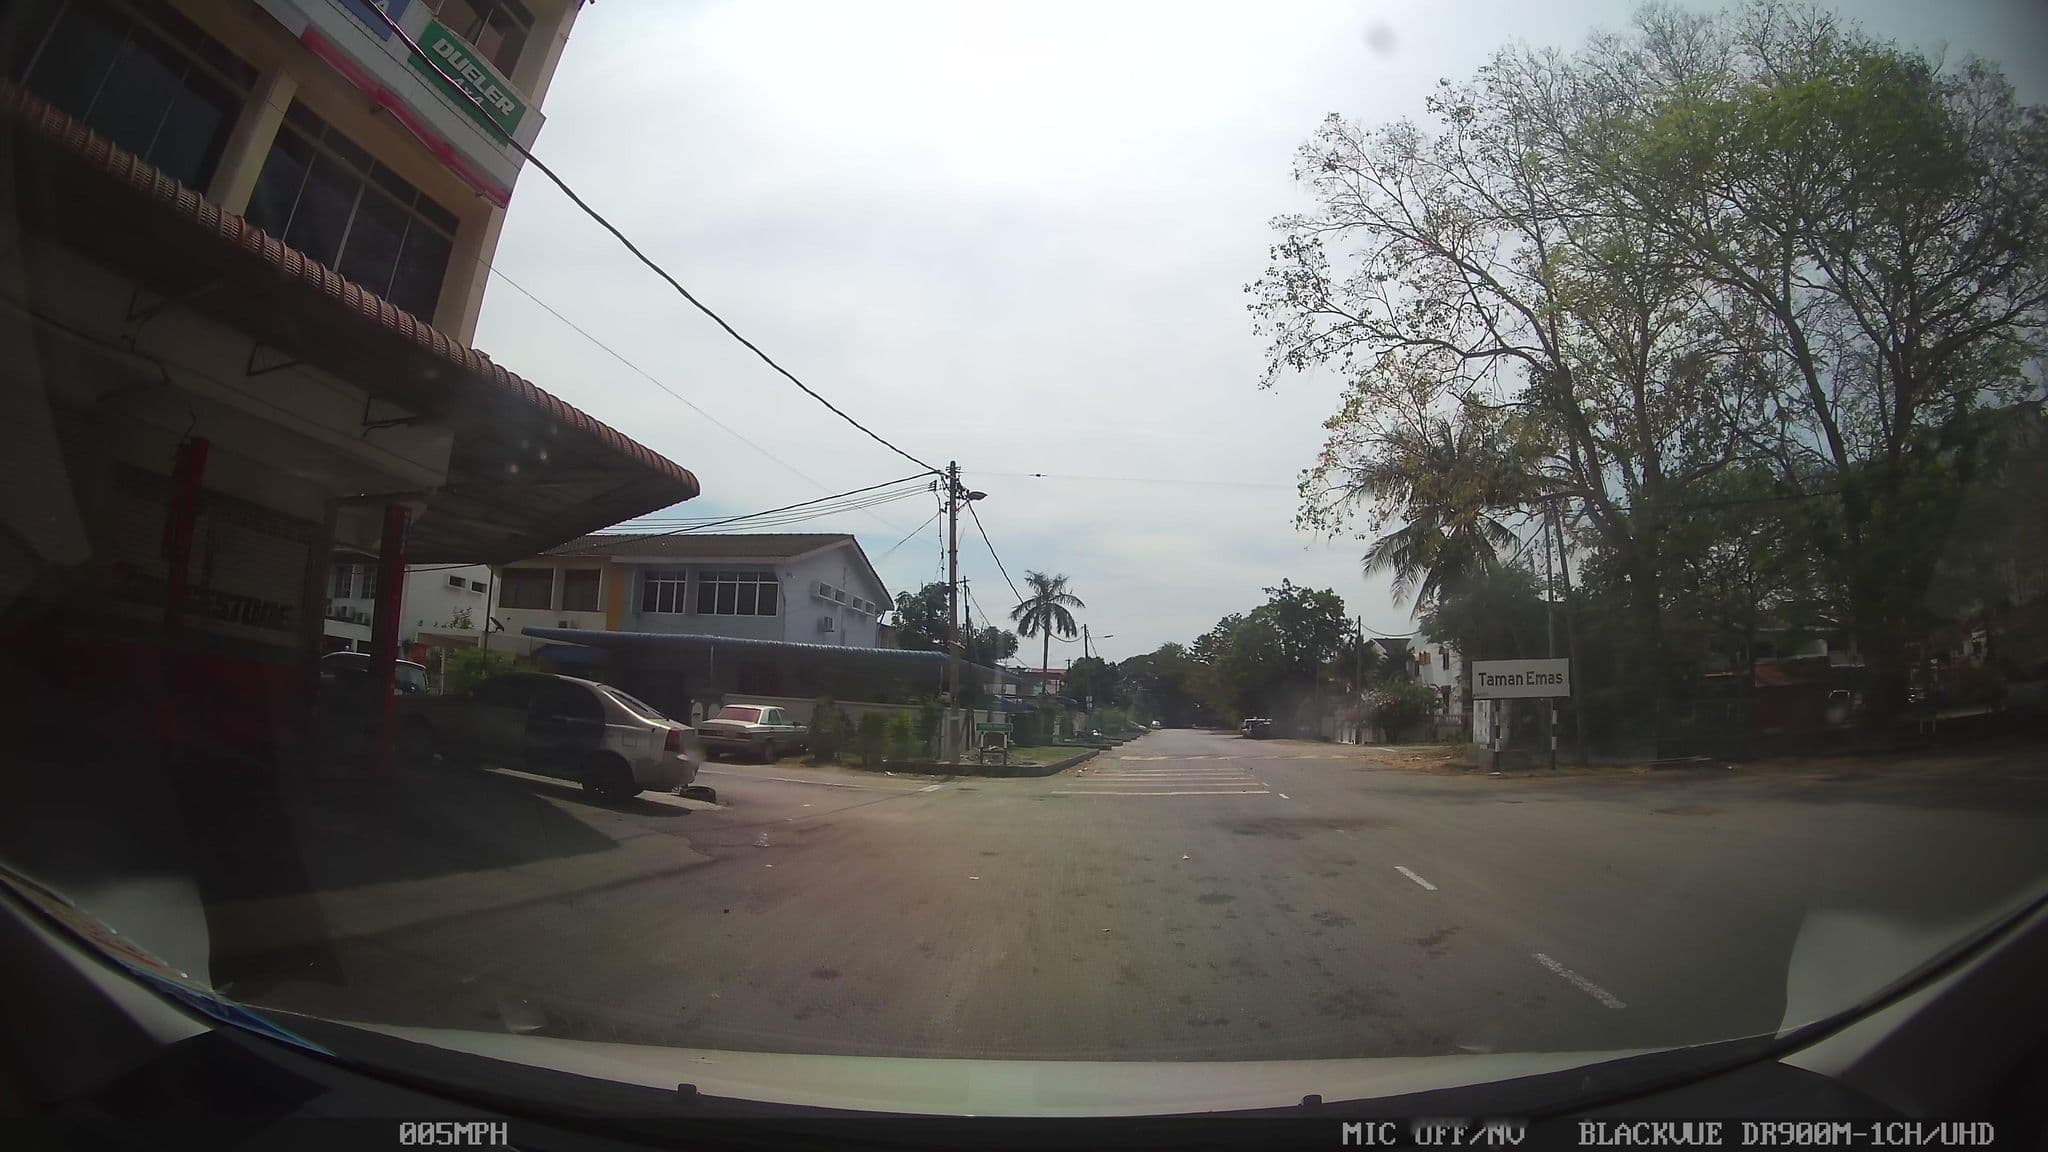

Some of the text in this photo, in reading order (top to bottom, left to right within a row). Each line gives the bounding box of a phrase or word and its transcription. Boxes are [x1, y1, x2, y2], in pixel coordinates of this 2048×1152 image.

[432, 38, 515, 116] DUELER
[1479, 671, 1563, 687] Taman Emas
